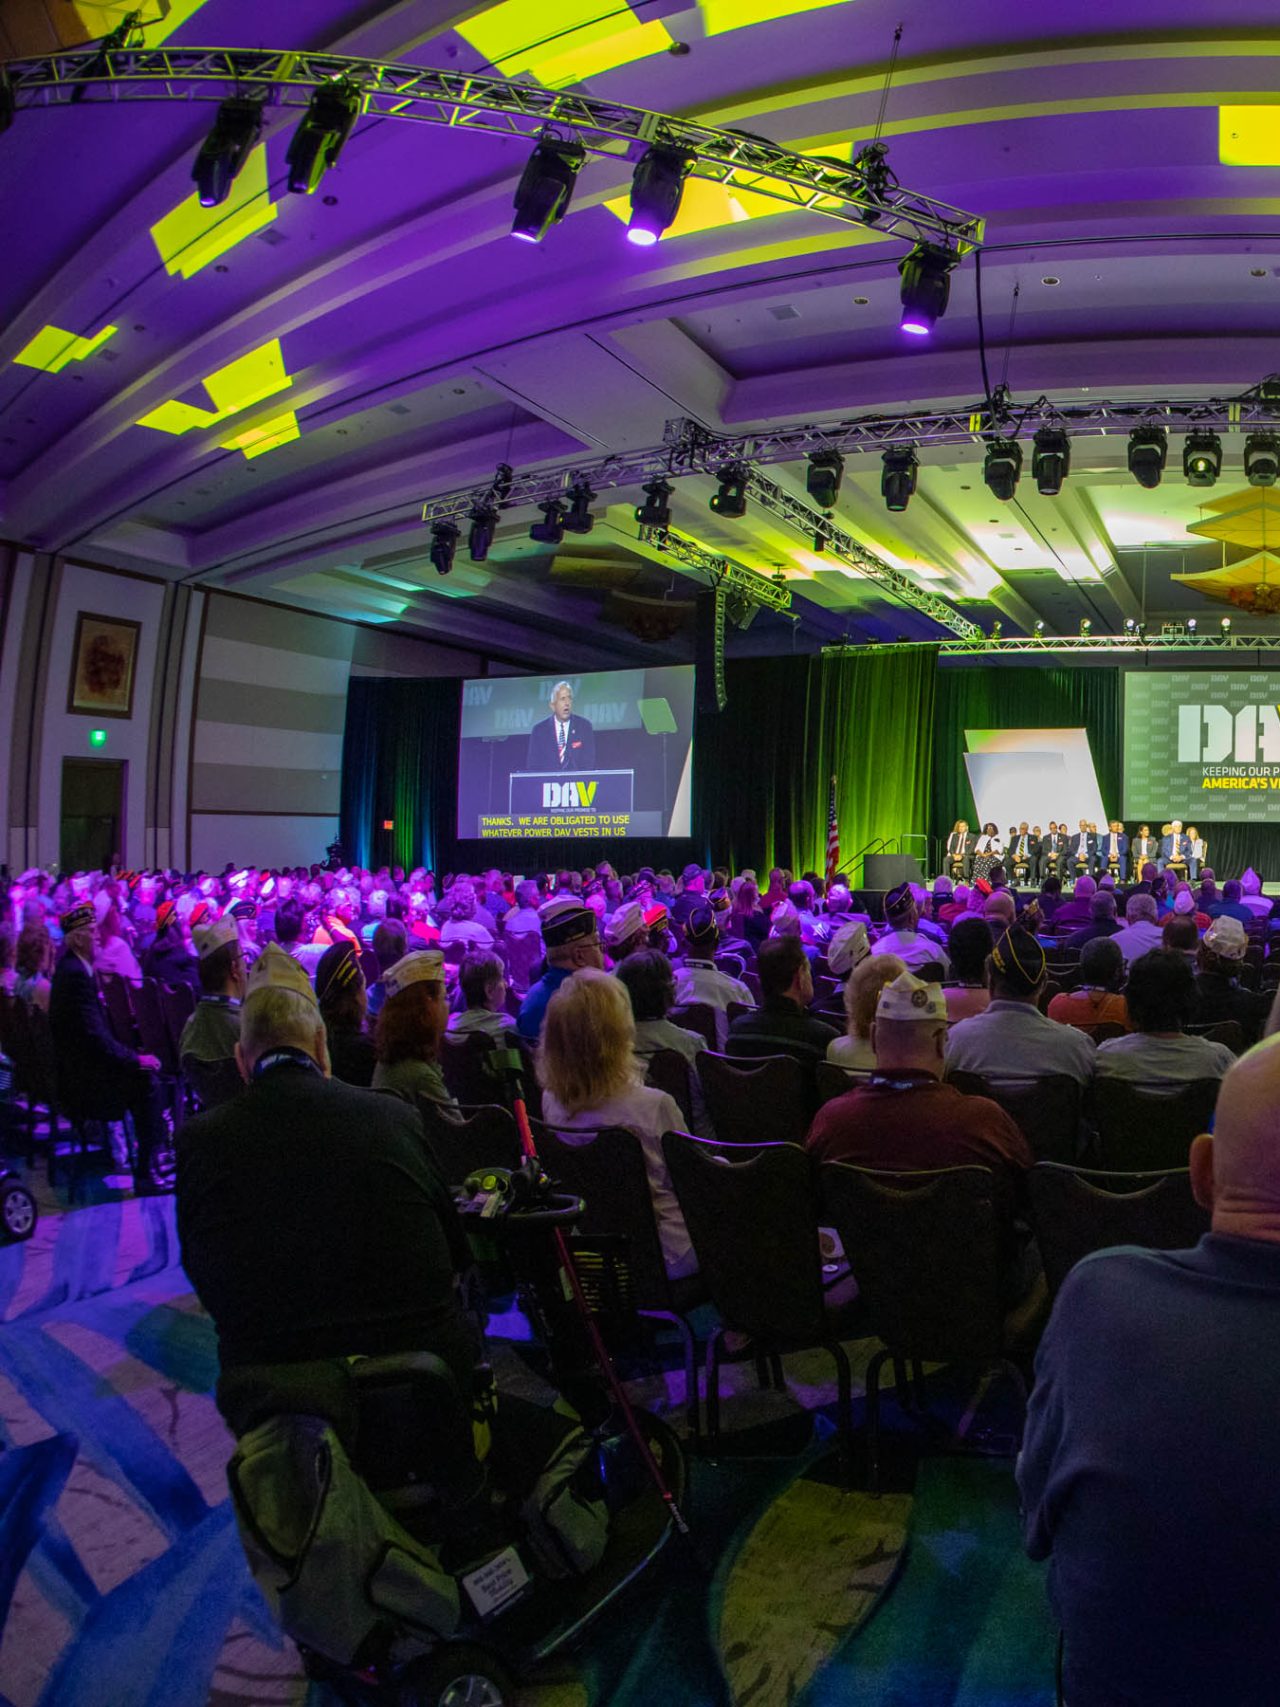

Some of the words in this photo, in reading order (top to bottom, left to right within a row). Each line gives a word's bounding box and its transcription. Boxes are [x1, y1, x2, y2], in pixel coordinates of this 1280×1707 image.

[1202, 766, 1246, 777] KEEPING
[1248, 766, 1271, 777] OUR
[1202, 777, 1268, 790] AMERICA'S
[542, 781, 597, 808] DAV
[482, 817, 514, 826] THANKS.
[519, 817, 531, 826] WE
[532, 816, 548, 825] ARE
[550, 816, 596, 825] OBLIGATED
[598, 816, 611, 824] TO
[613, 815, 630, 824] USE
[482, 829, 522, 837] WHATEVER
[524, 828, 551, 837] POWER
[554, 828, 571, 836] DAV
[573, 827, 600, 836] VESTS
[602, 827, 612, 836] IN
[614, 827, 626, 836] US
